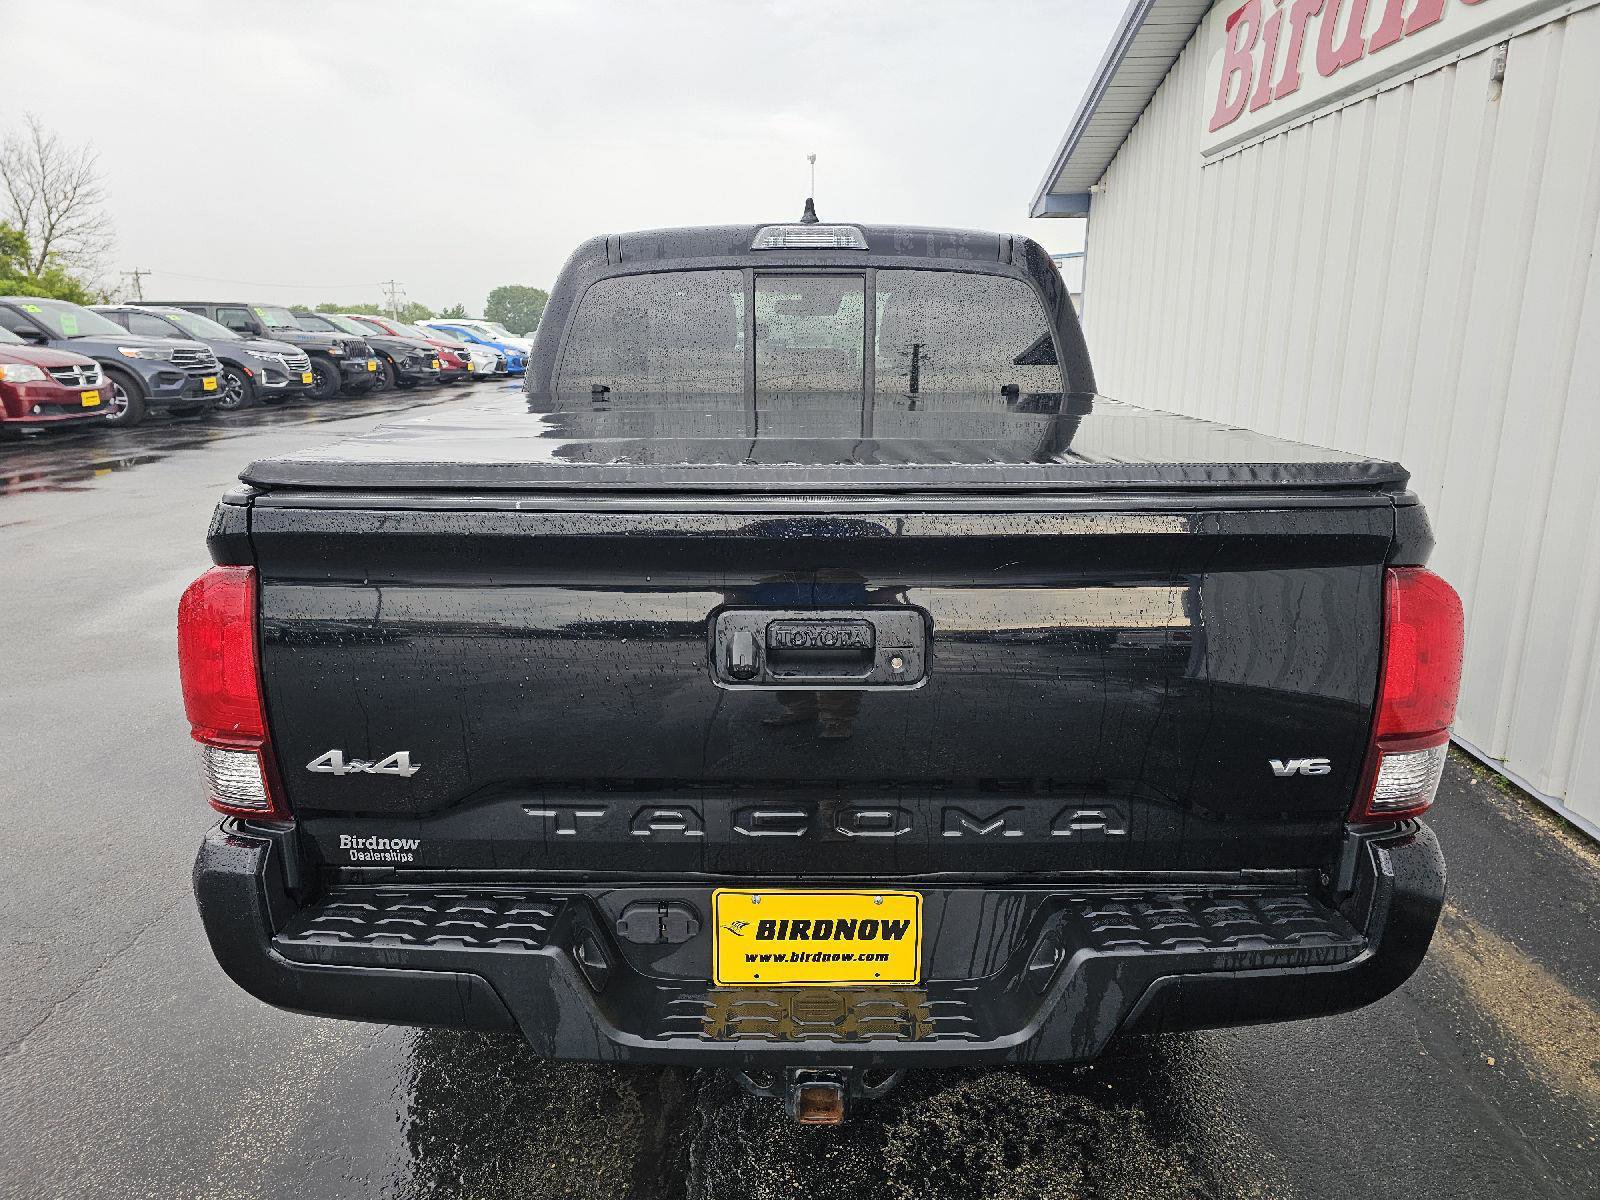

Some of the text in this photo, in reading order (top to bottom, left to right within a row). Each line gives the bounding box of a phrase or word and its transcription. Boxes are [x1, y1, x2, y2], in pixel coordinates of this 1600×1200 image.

[776, 629, 868, 647] TOYOTA
[1268, 758, 1332, 777] V6
[521, 804, 1126, 837] TACOMA
[339, 834, 421, 850] Birdnow
[349, 849, 414, 862] Dealerships
[755, 918, 911, 941] BIRDNOW
[744, 951, 890, 963] www.birdnow.com
